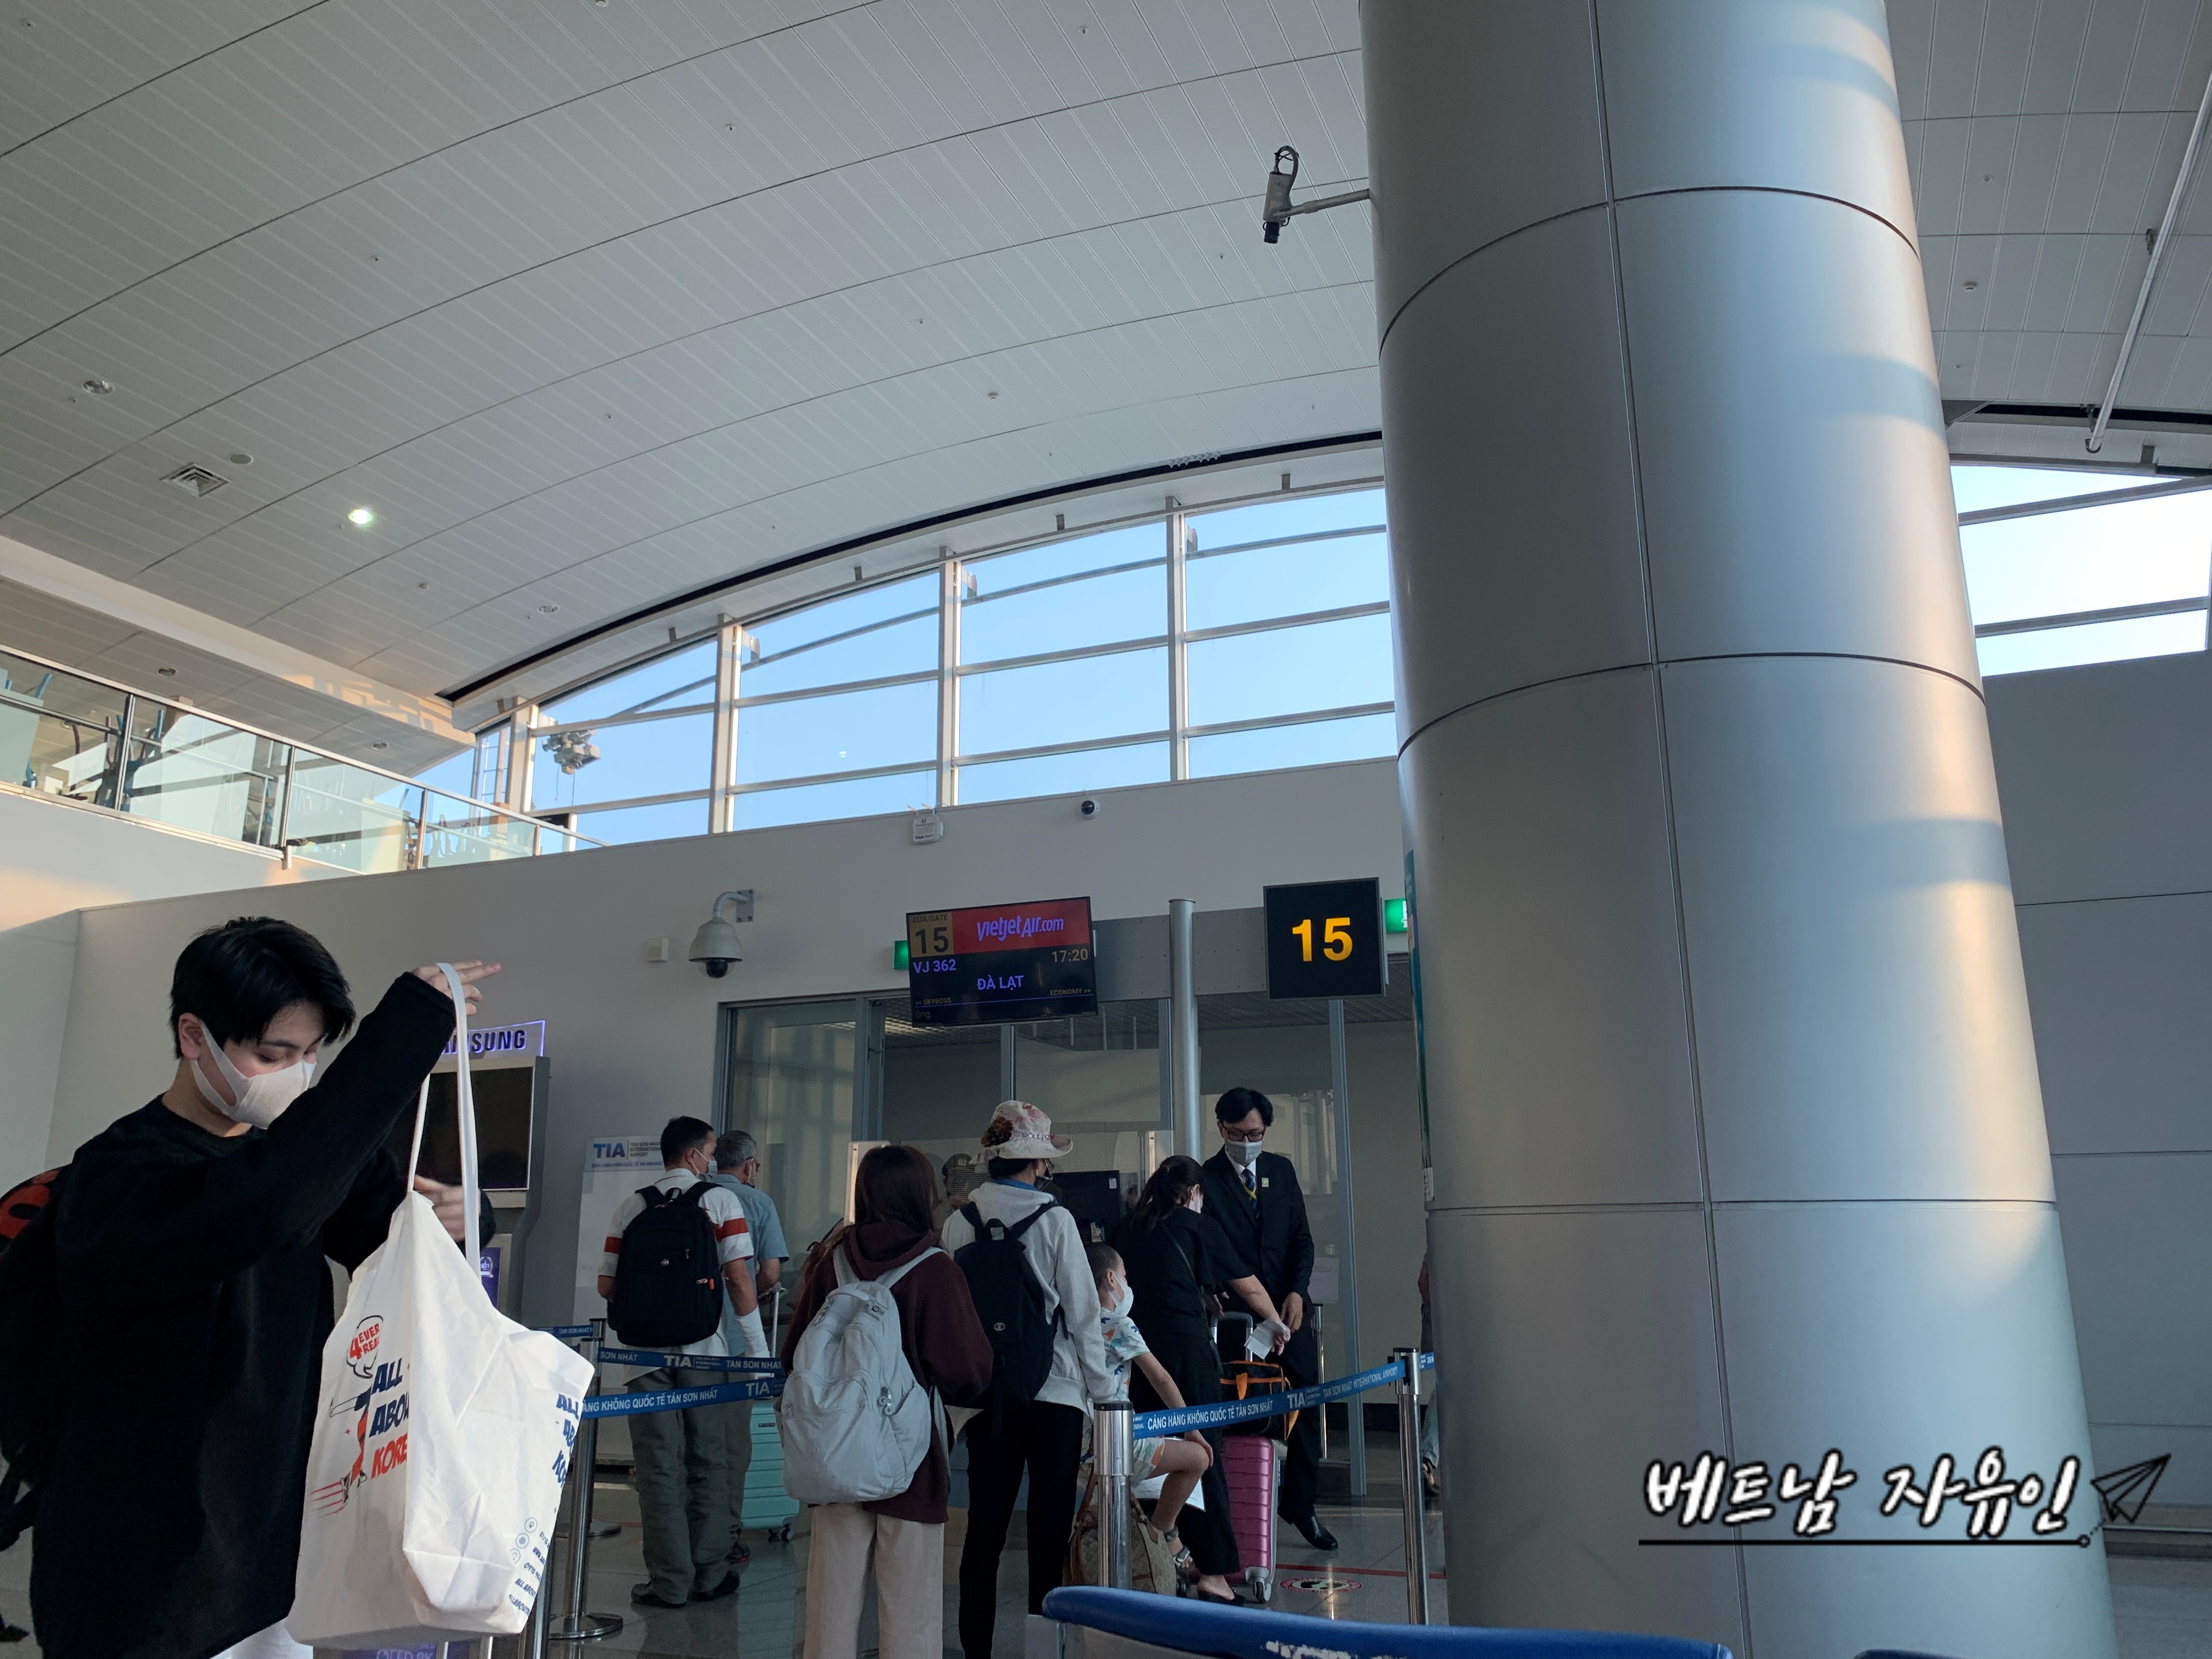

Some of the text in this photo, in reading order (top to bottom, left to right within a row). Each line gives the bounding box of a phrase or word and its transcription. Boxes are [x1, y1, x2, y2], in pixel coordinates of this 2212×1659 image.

[915, 926, 949, 953] 15
[1292, 917, 1353, 962] 15
[913, 959, 957, 974] VJ 362
[1052, 949, 1088, 963] 17:20
[977, 975, 1024, 990] ĐÀ LẠT
[1050, 988, 1082, 996] ECONOMY
[593, 1143, 625, 1158] TIA
[664, 1355, 692, 1368] TIA
[371, 1357, 403, 1391] ALL
[1323, 1387, 1332, 1398] TAN
[1332, 1385, 1341, 1396] SON
[1341, 1381, 1352, 1393] NHAT
[1353, 1373, 1383, 1389] INTERNATIONAL
[1383, 1366, 1398, 1379] AIRPORT
[582, 1399, 600, 1413] ÀNG
[601, 1397, 630, 1411] KHÔNG
[633, 1393, 654, 1408] QUỐC
[656, 1392, 666, 1405] TẾ
[683, 1392, 698, 1402] SƠN
[699, 1386, 718, 1400] NHẤT
[746, 1381, 770, 1396] TIA
[556, 1393, 579, 1420] ALL
[1287, 1392, 1306, 1409] TIA
[1148, 1414, 1166, 1430] CẢNG
[1168, 1412, 1186, 1427] HÀNG
[1187, 1409, 1209, 1424] KHÔNG
[1210, 1406, 1227, 1422] QUỐC
[1228, 1404, 1235, 1419] TẾ
[1235, 1404, 1246, 1417] TÂN
[1247, 1404, 1259, 1415] SƠN
[1260, 1398, 1273, 1413] NHẤT
[371, 1433, 408, 1479] KORE
